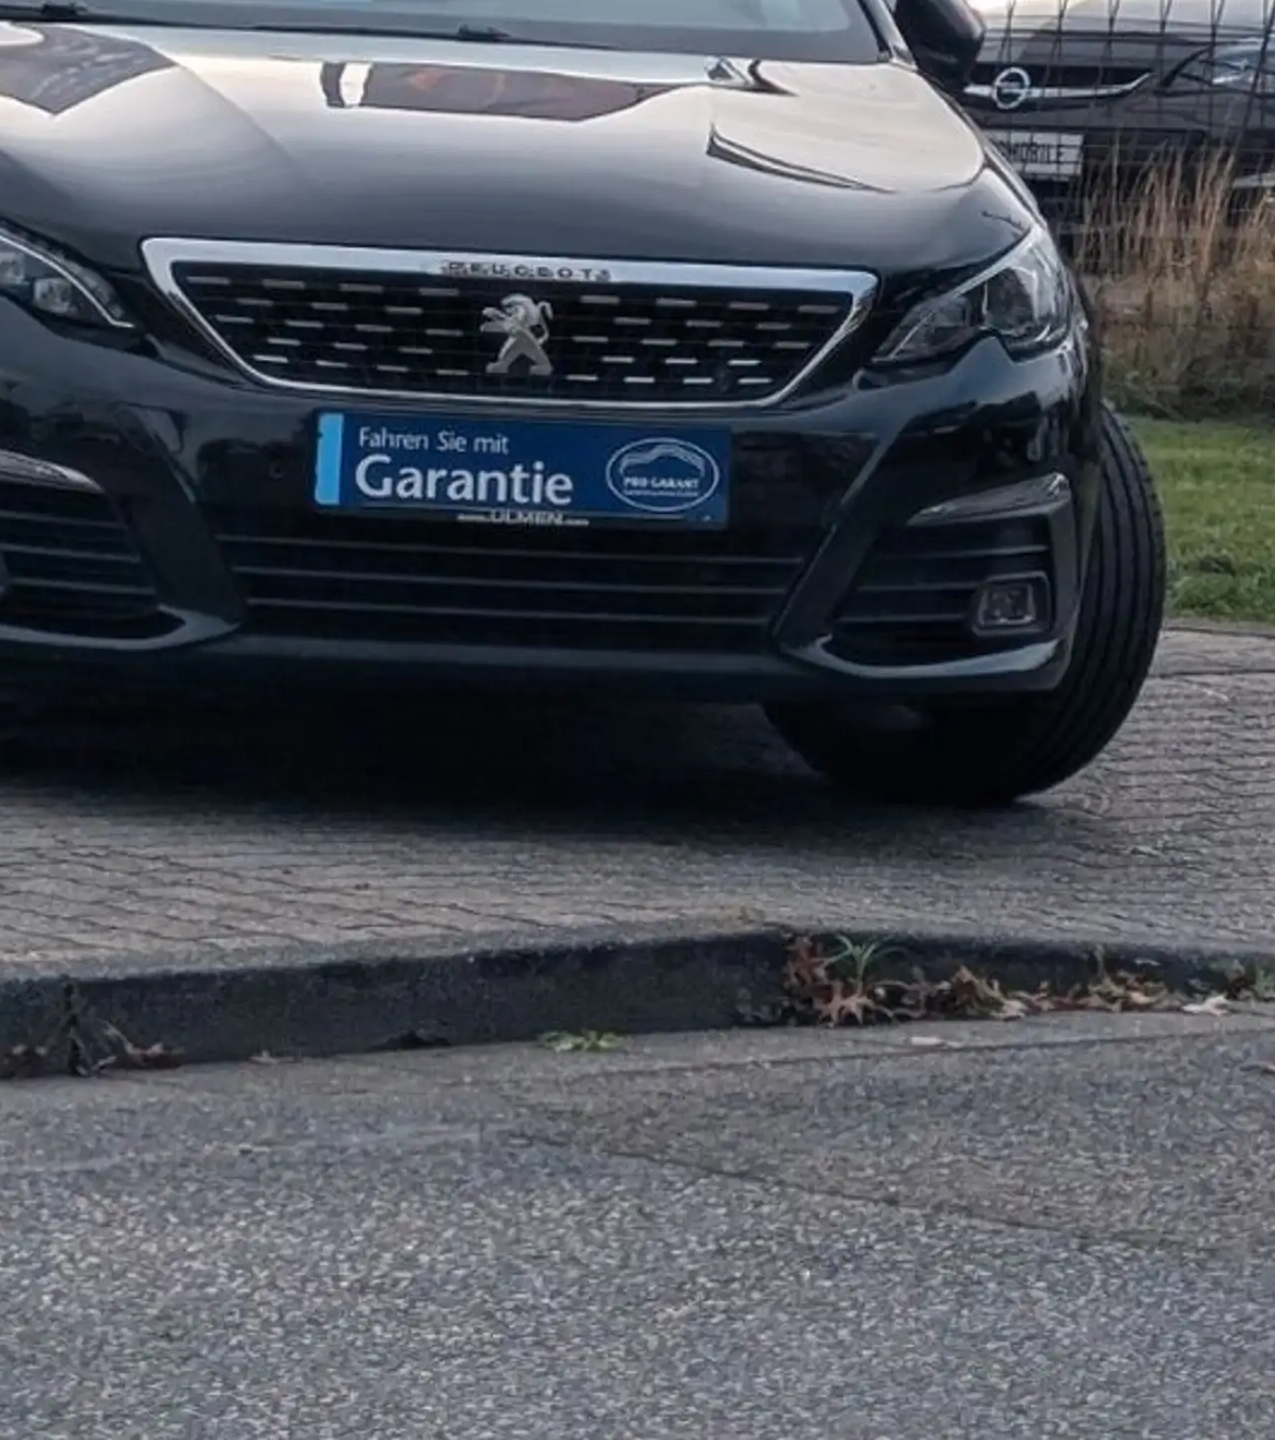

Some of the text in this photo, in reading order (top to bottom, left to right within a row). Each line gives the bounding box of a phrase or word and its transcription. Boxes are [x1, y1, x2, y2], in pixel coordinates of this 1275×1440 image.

[358, 426, 510, 455] Fahren Sie mit
[354, 453, 574, 505] Garantie
